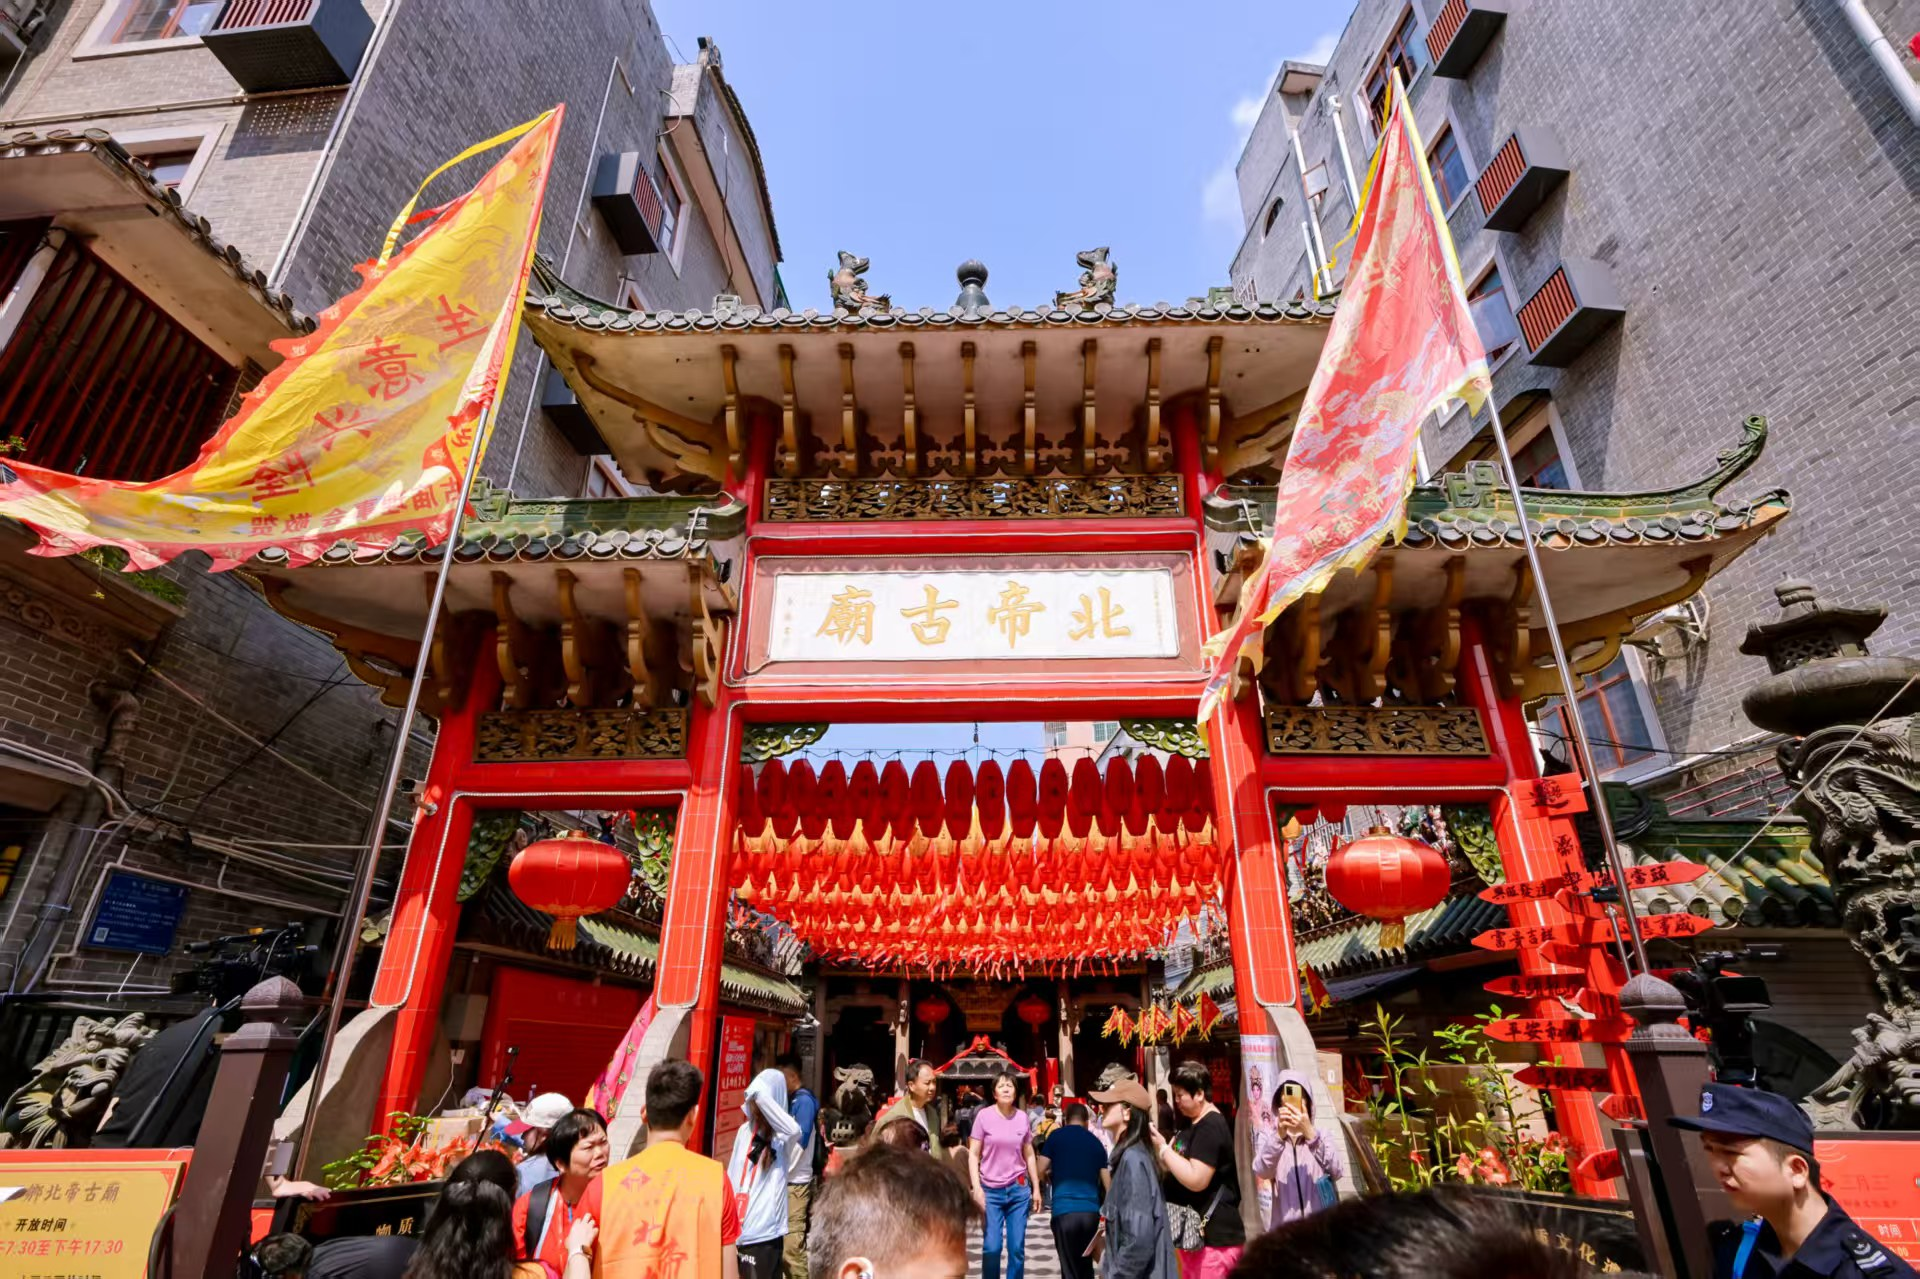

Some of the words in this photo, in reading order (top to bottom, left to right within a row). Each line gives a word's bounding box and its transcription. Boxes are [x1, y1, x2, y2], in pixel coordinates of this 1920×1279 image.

[15, 1217, 68, 1232] 开放时间
[1878, 1225, 1902, 1239] 时间
